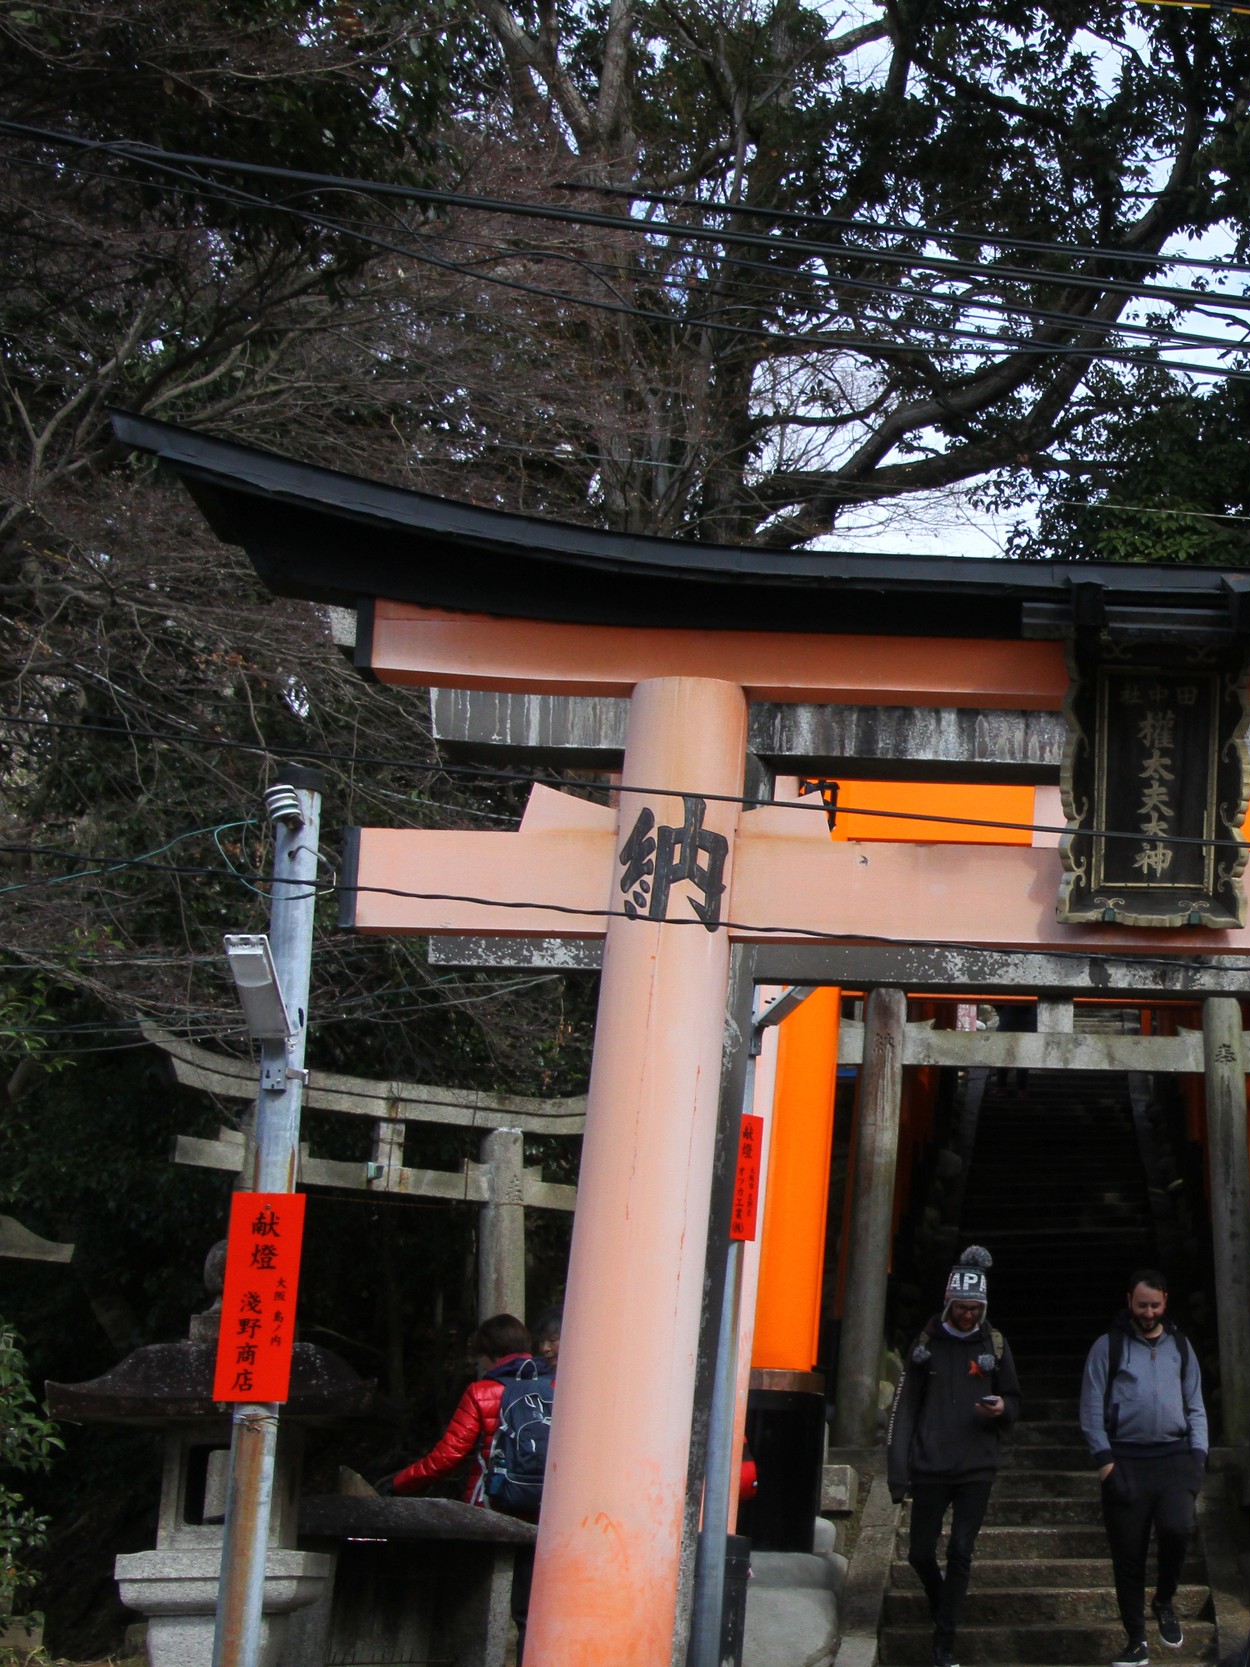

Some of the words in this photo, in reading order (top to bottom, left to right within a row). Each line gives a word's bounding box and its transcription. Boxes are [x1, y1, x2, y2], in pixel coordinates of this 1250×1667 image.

[619, 795, 729, 933] 納
[249, 1211, 281, 1271] 献燈
[273, 1277, 288, 1302] 大阪
